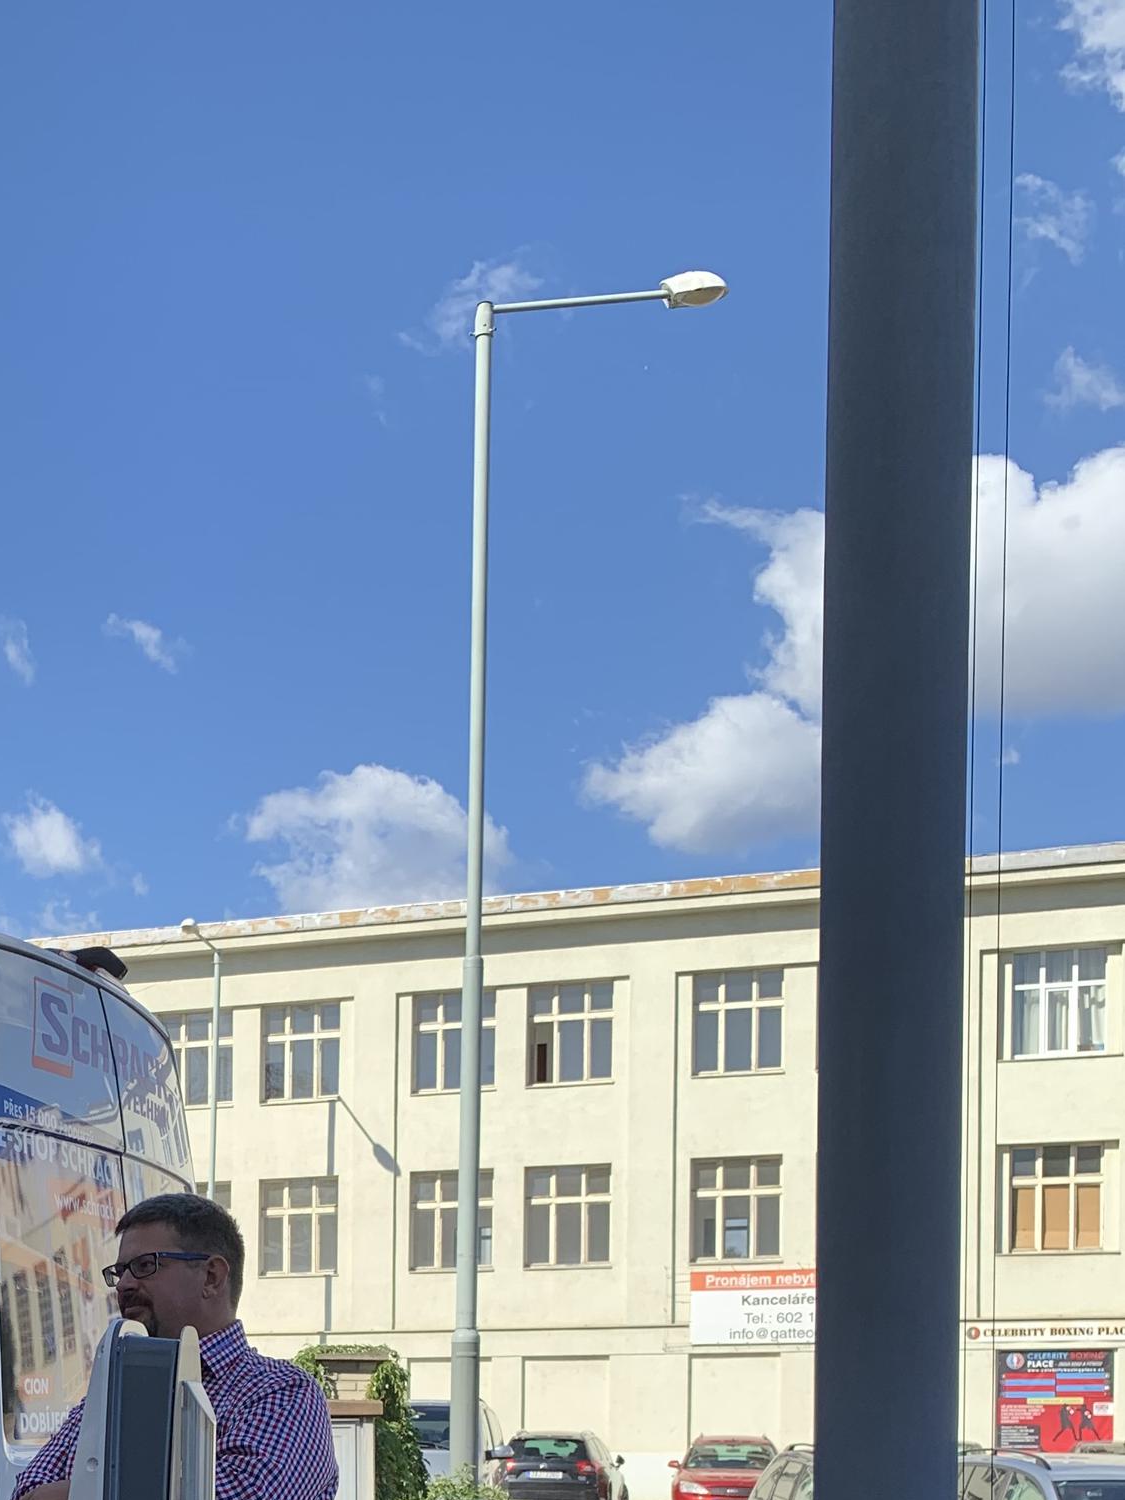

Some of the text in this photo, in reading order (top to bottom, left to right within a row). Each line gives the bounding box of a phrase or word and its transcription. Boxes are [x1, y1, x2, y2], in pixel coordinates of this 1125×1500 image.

[3, 1099, 23, 1118] PŘES
[24, 1104, 36, 1125] 15
[705, 1274, 771, 1287] Pronájem
[741, 1293, 815, 1306] Kanceláře
[744, 1311, 815, 1325] Tel.: 602 1
[983, 1328, 1046, 1337] CELEBRITY
[1050, 1326, 1094, 1337] BOXING
[1027, 1360, 1054, 1368] PLACE
[23, 1377, 49, 1395] CION
